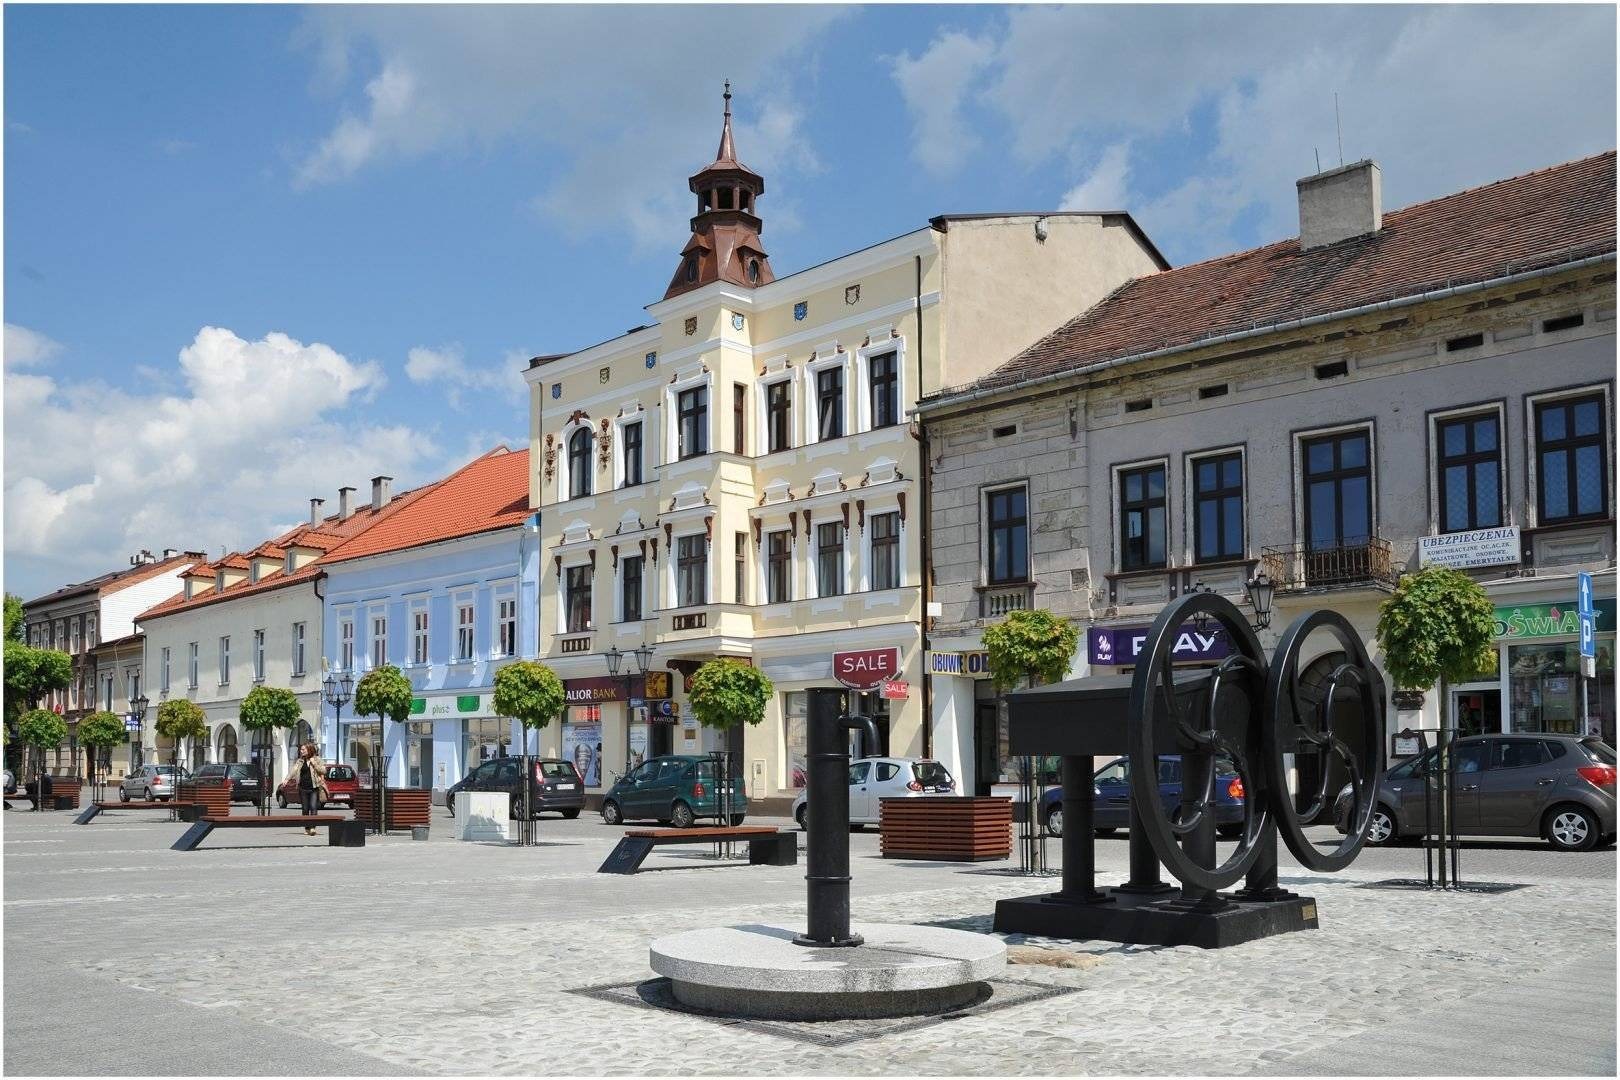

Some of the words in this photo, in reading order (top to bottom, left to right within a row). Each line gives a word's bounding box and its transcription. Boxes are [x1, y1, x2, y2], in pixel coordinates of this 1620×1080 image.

[1423, 528, 1515, 547] UBEZPIECZENIA
[1465, 555, 1516, 566] EMERYTALNE
[1583, 619, 1591, 650] P
[1132, 630, 1220, 657] PAY
[842, 654, 888, 673] SALE
[932, 653, 964, 674] OBUWIE
[1097, 653, 1112, 661] PLAY
[566, 689, 592, 701] ALIOR
[593, 687, 617, 699] BANK
[885, 684, 906, 693] SALE
[653, 715, 676, 724] KANTOR
